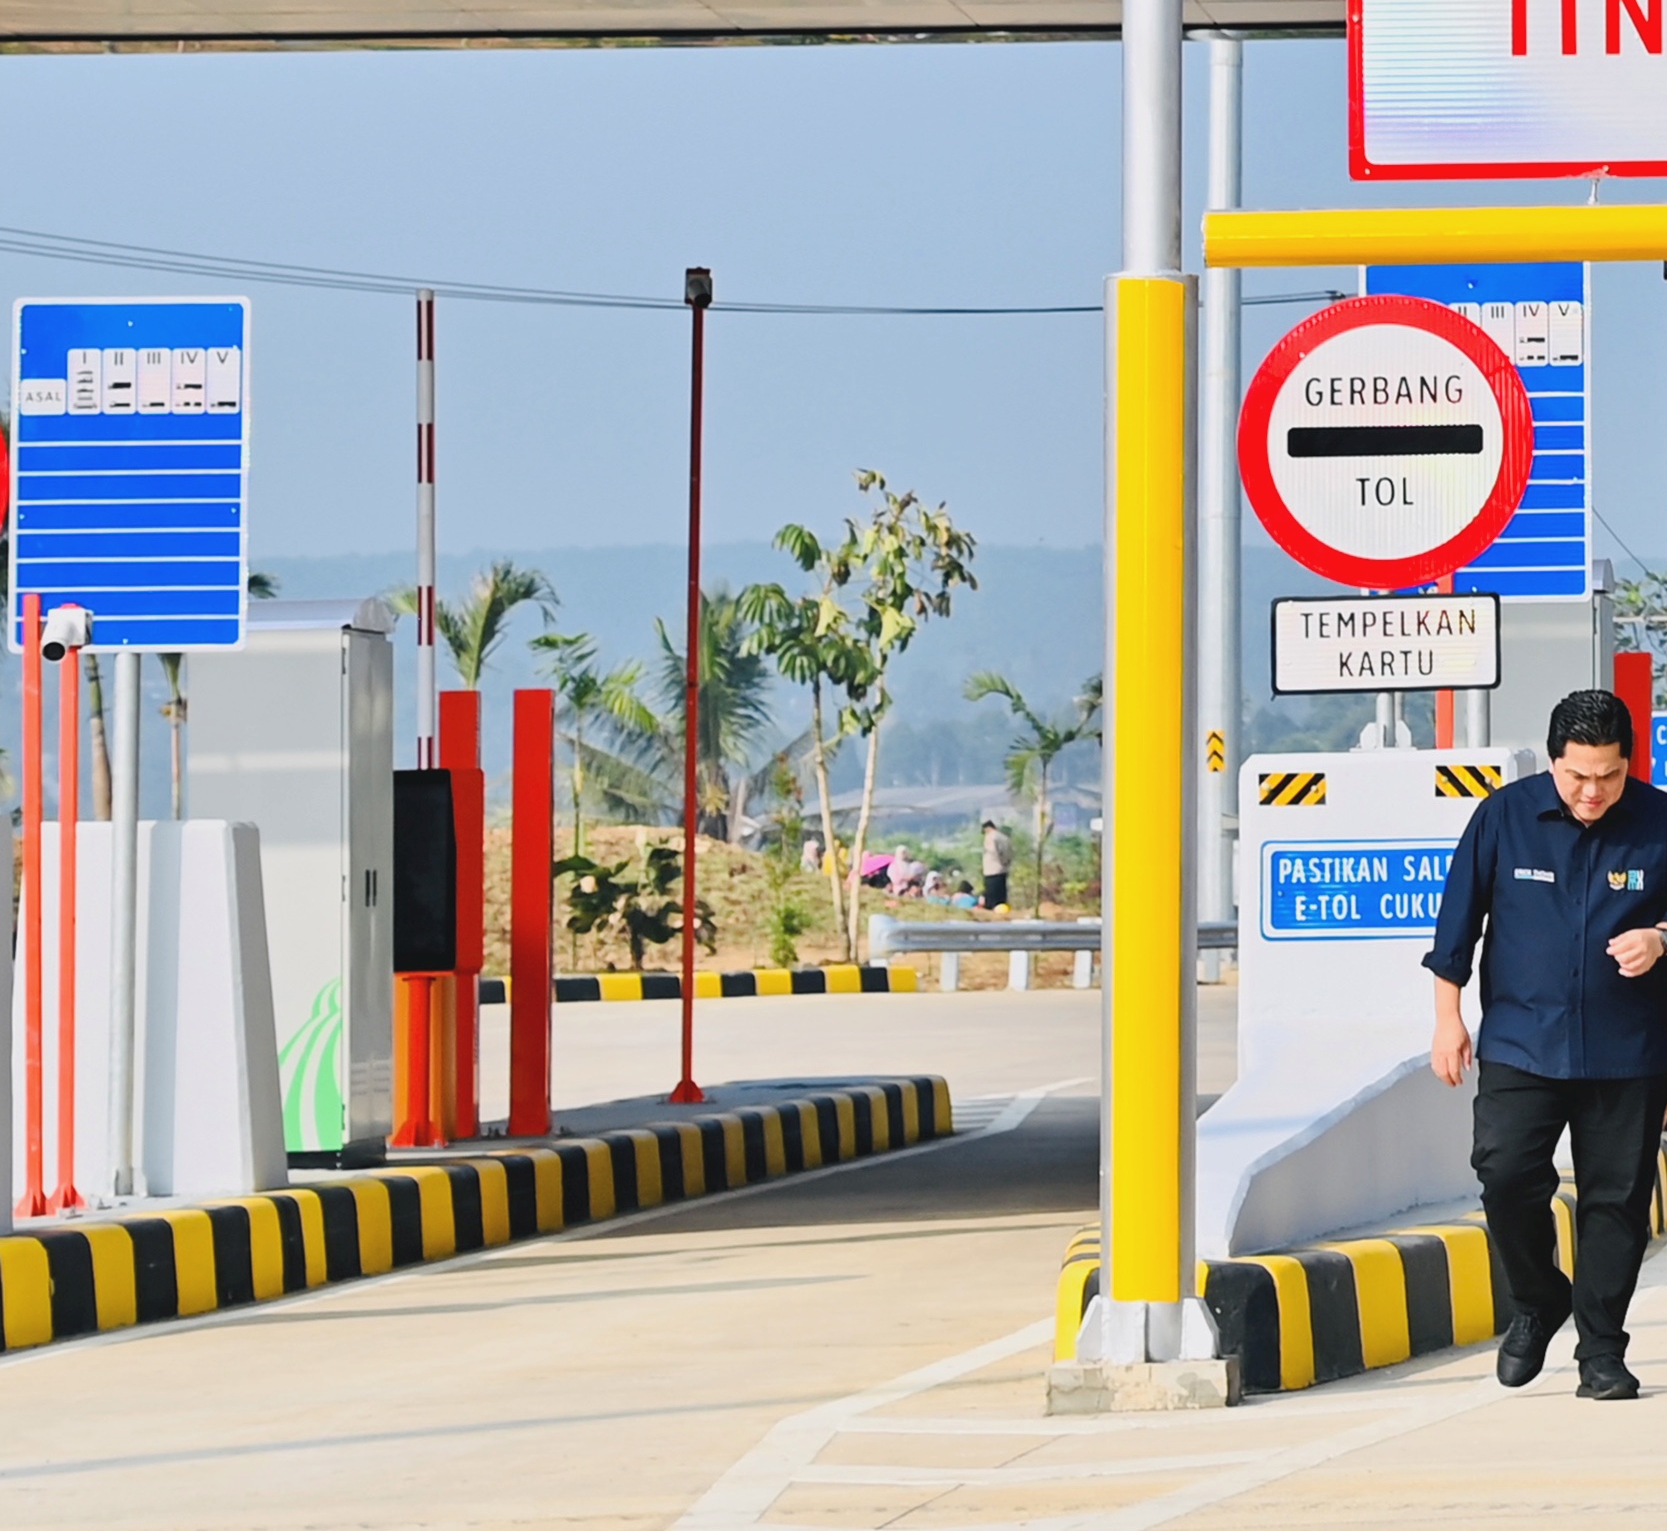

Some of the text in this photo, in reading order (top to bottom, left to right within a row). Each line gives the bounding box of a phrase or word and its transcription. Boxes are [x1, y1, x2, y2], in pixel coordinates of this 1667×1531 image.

[1491, 306, 1505, 319] III
[1523, 304, 1540, 317] IV
[1558, 304, 1570, 317] V
[114, 352, 124, 365] II
[147, 352, 161, 365] III
[181, 351, 198, 364] IV
[217, 351, 229, 364] V
[25, 391, 62, 402] ASAL
[1304, 374, 1463, 407] GERBANG
[1356, 477, 1414, 506] TOL
[1301, 609, 1475, 638] TEMPELKAN
[1339, 650, 1433, 677] KARTU
[1279, 855, 1454, 884] PASTIKAN SAL
[1295, 892, 1441, 921] E-TOL CUKU
